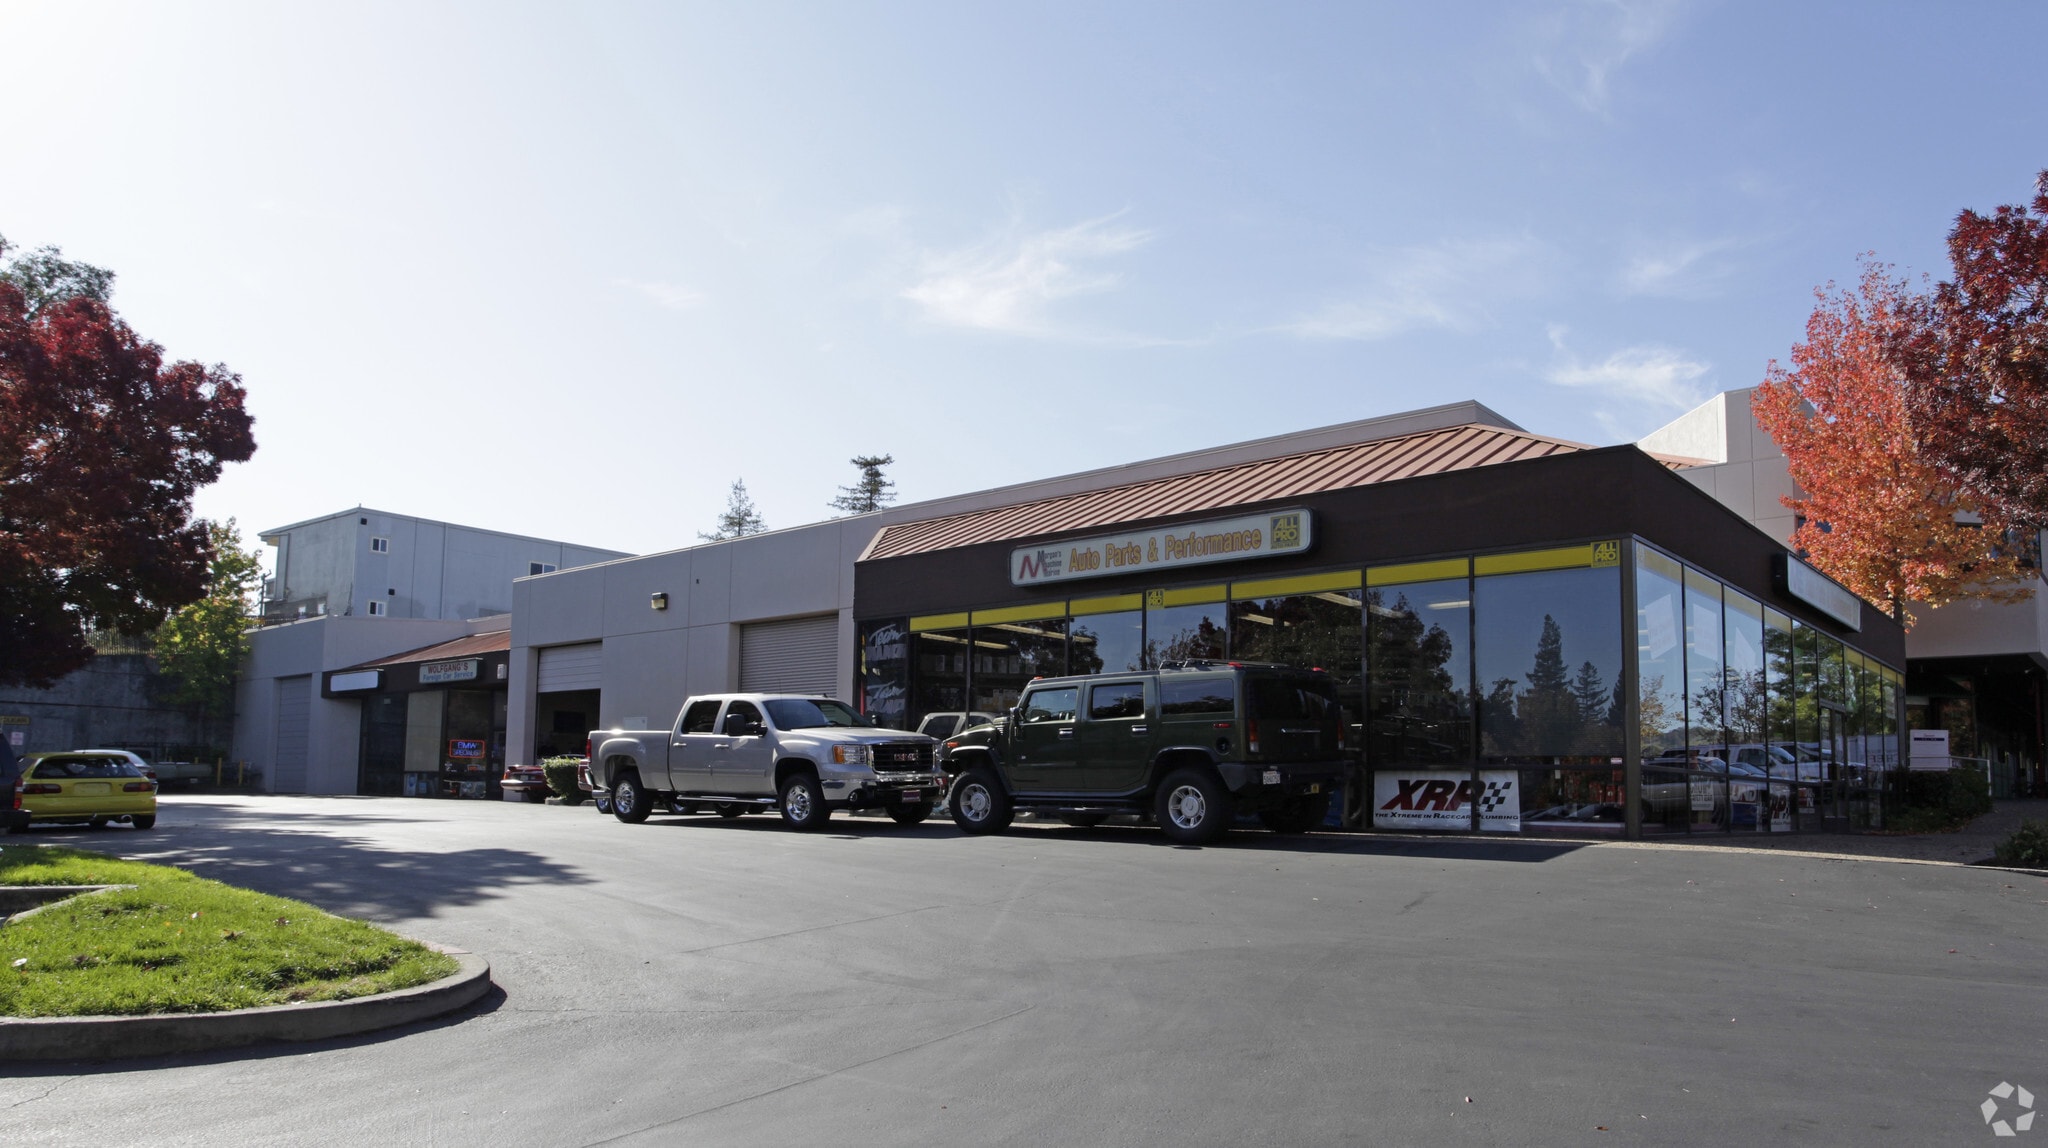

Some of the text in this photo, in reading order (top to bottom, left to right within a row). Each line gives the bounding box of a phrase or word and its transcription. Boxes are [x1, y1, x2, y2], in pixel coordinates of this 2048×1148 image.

[1274, 517, 1297, 531] ALL
[1274, 529, 1297, 542] PRO
[1069, 528, 1262, 572] Auto Parts & Performance
[428, 662, 469, 674] WOLFGANG'S
[1380, 779, 1487, 812] XRP
[1433, 812, 1472, 820] RACECAR
